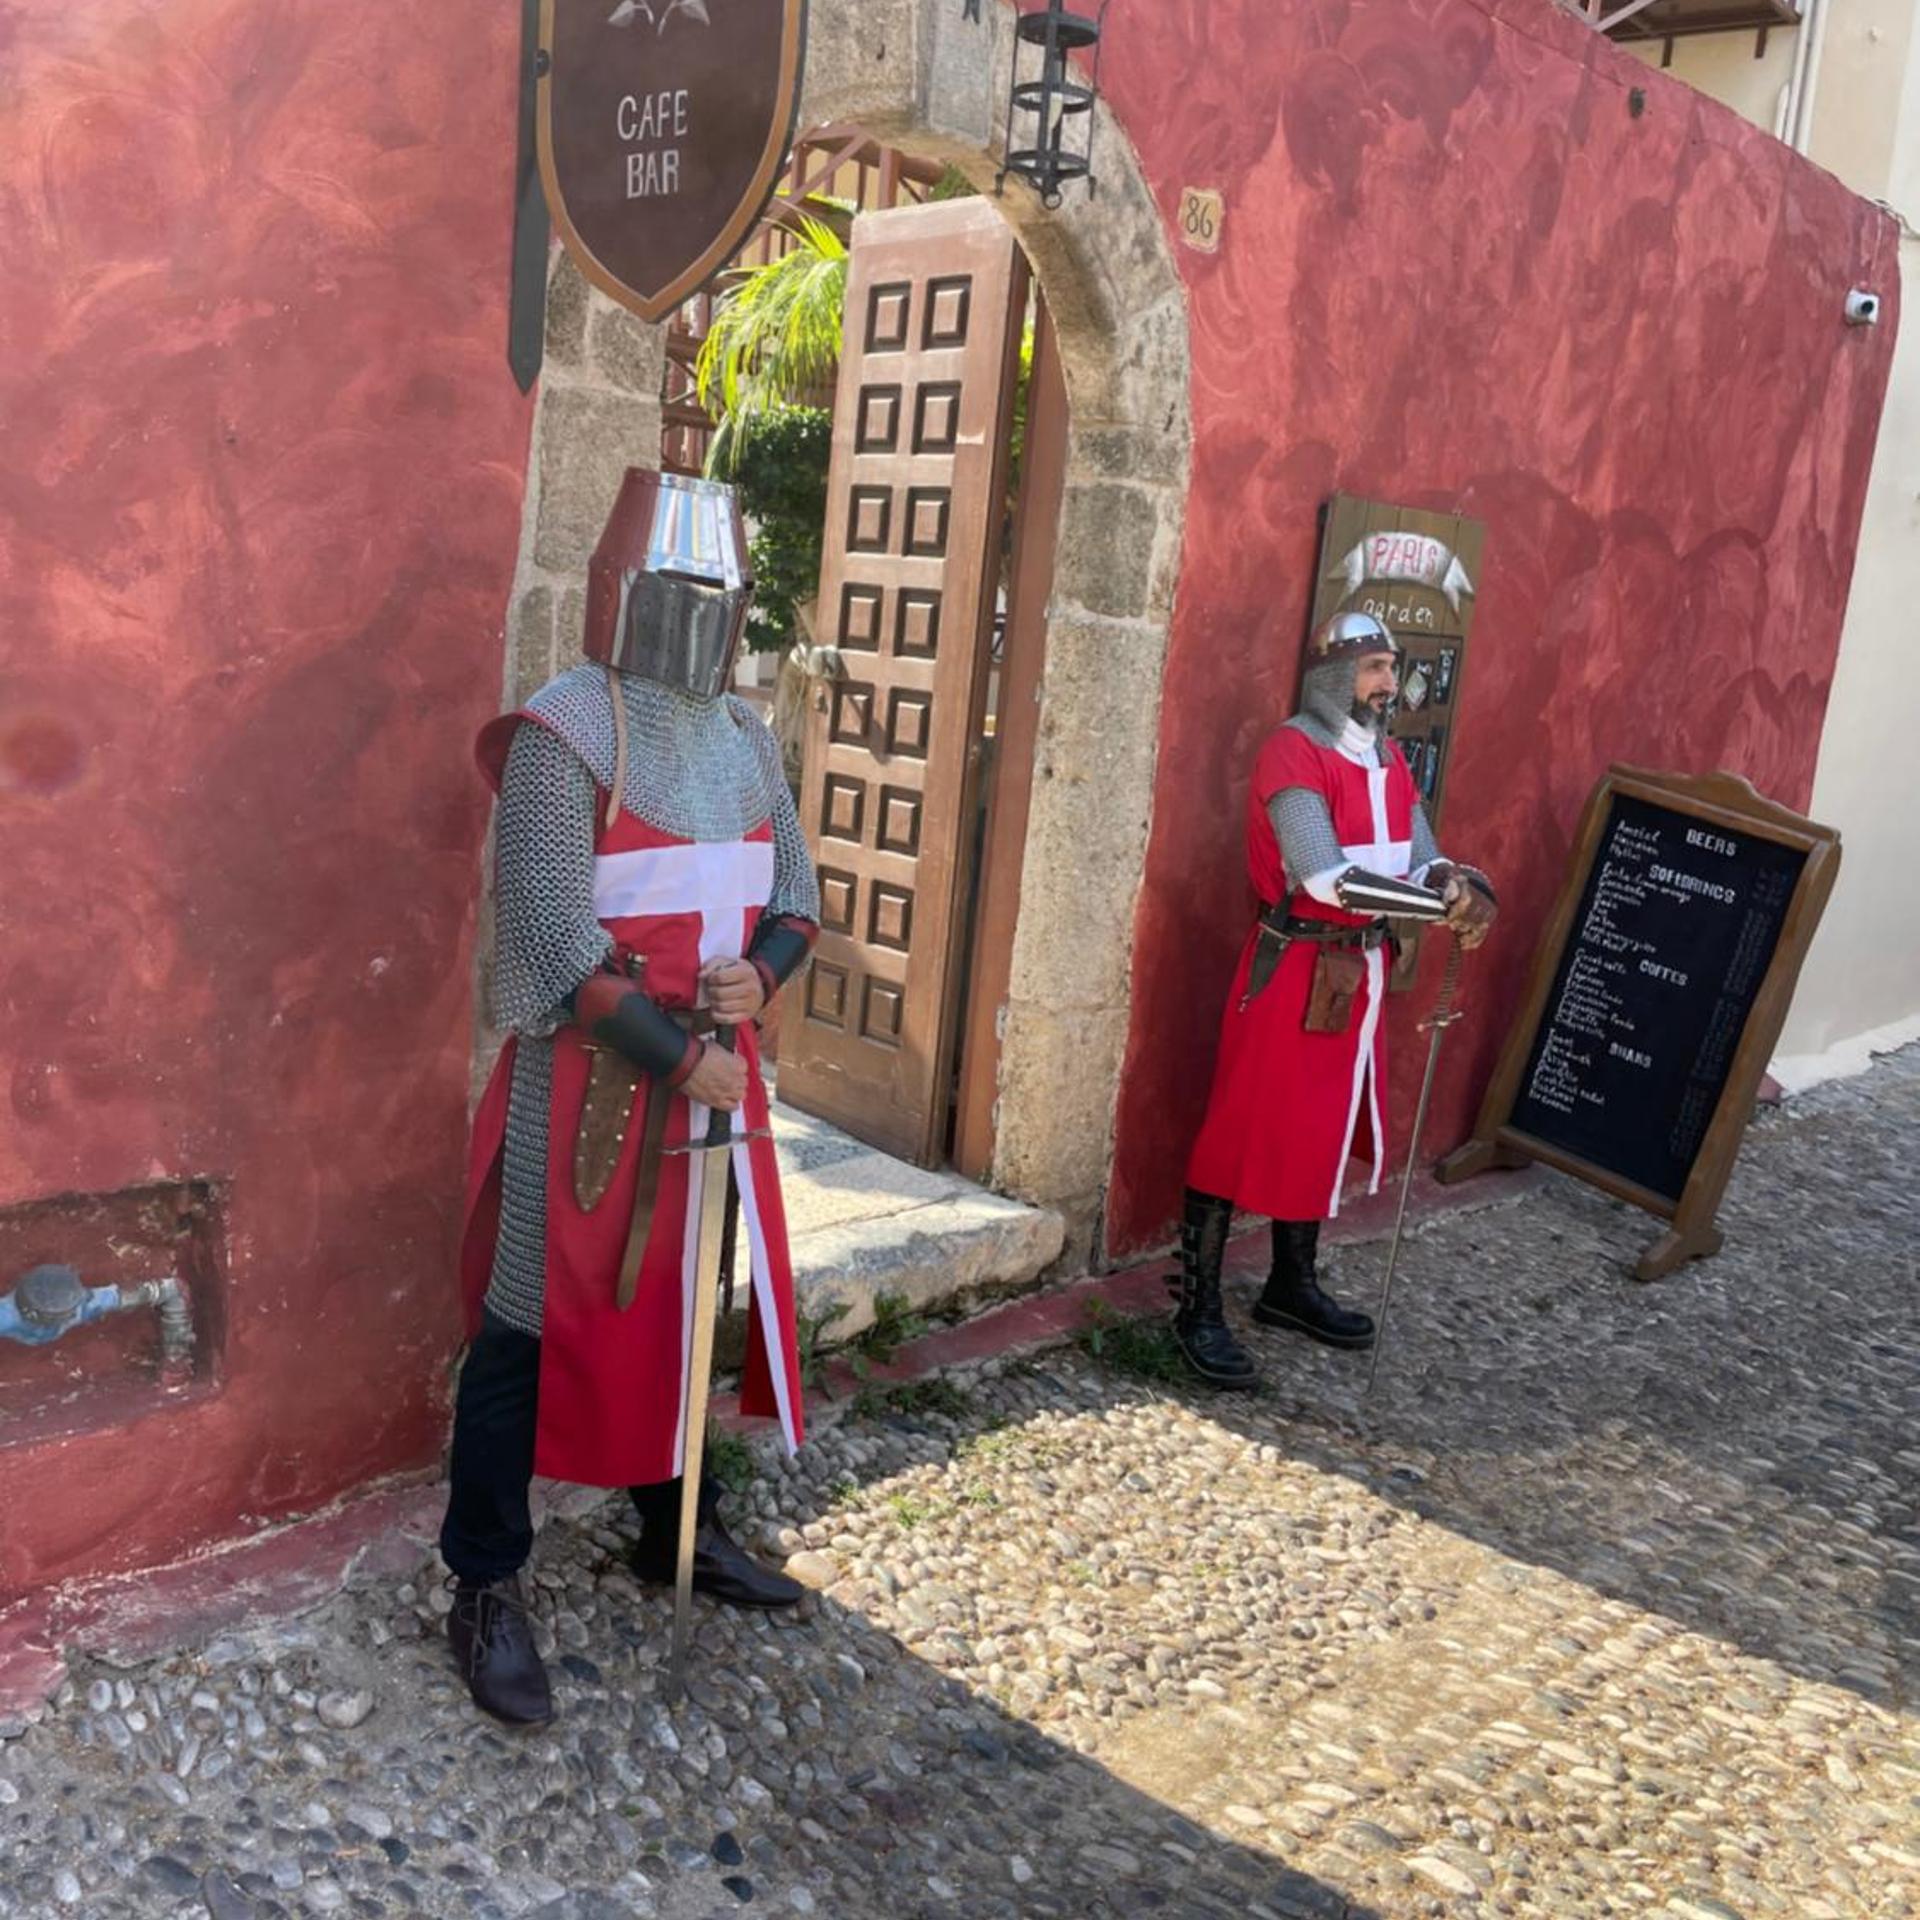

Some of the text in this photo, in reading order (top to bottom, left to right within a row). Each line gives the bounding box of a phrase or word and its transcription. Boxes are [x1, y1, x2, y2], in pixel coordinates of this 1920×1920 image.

[617, 89, 689, 140] CAFE
[627, 150, 680, 199] BAR
[1186, 196, 1213, 239] 86
[1685, 828, 1736, 856] BEERS
